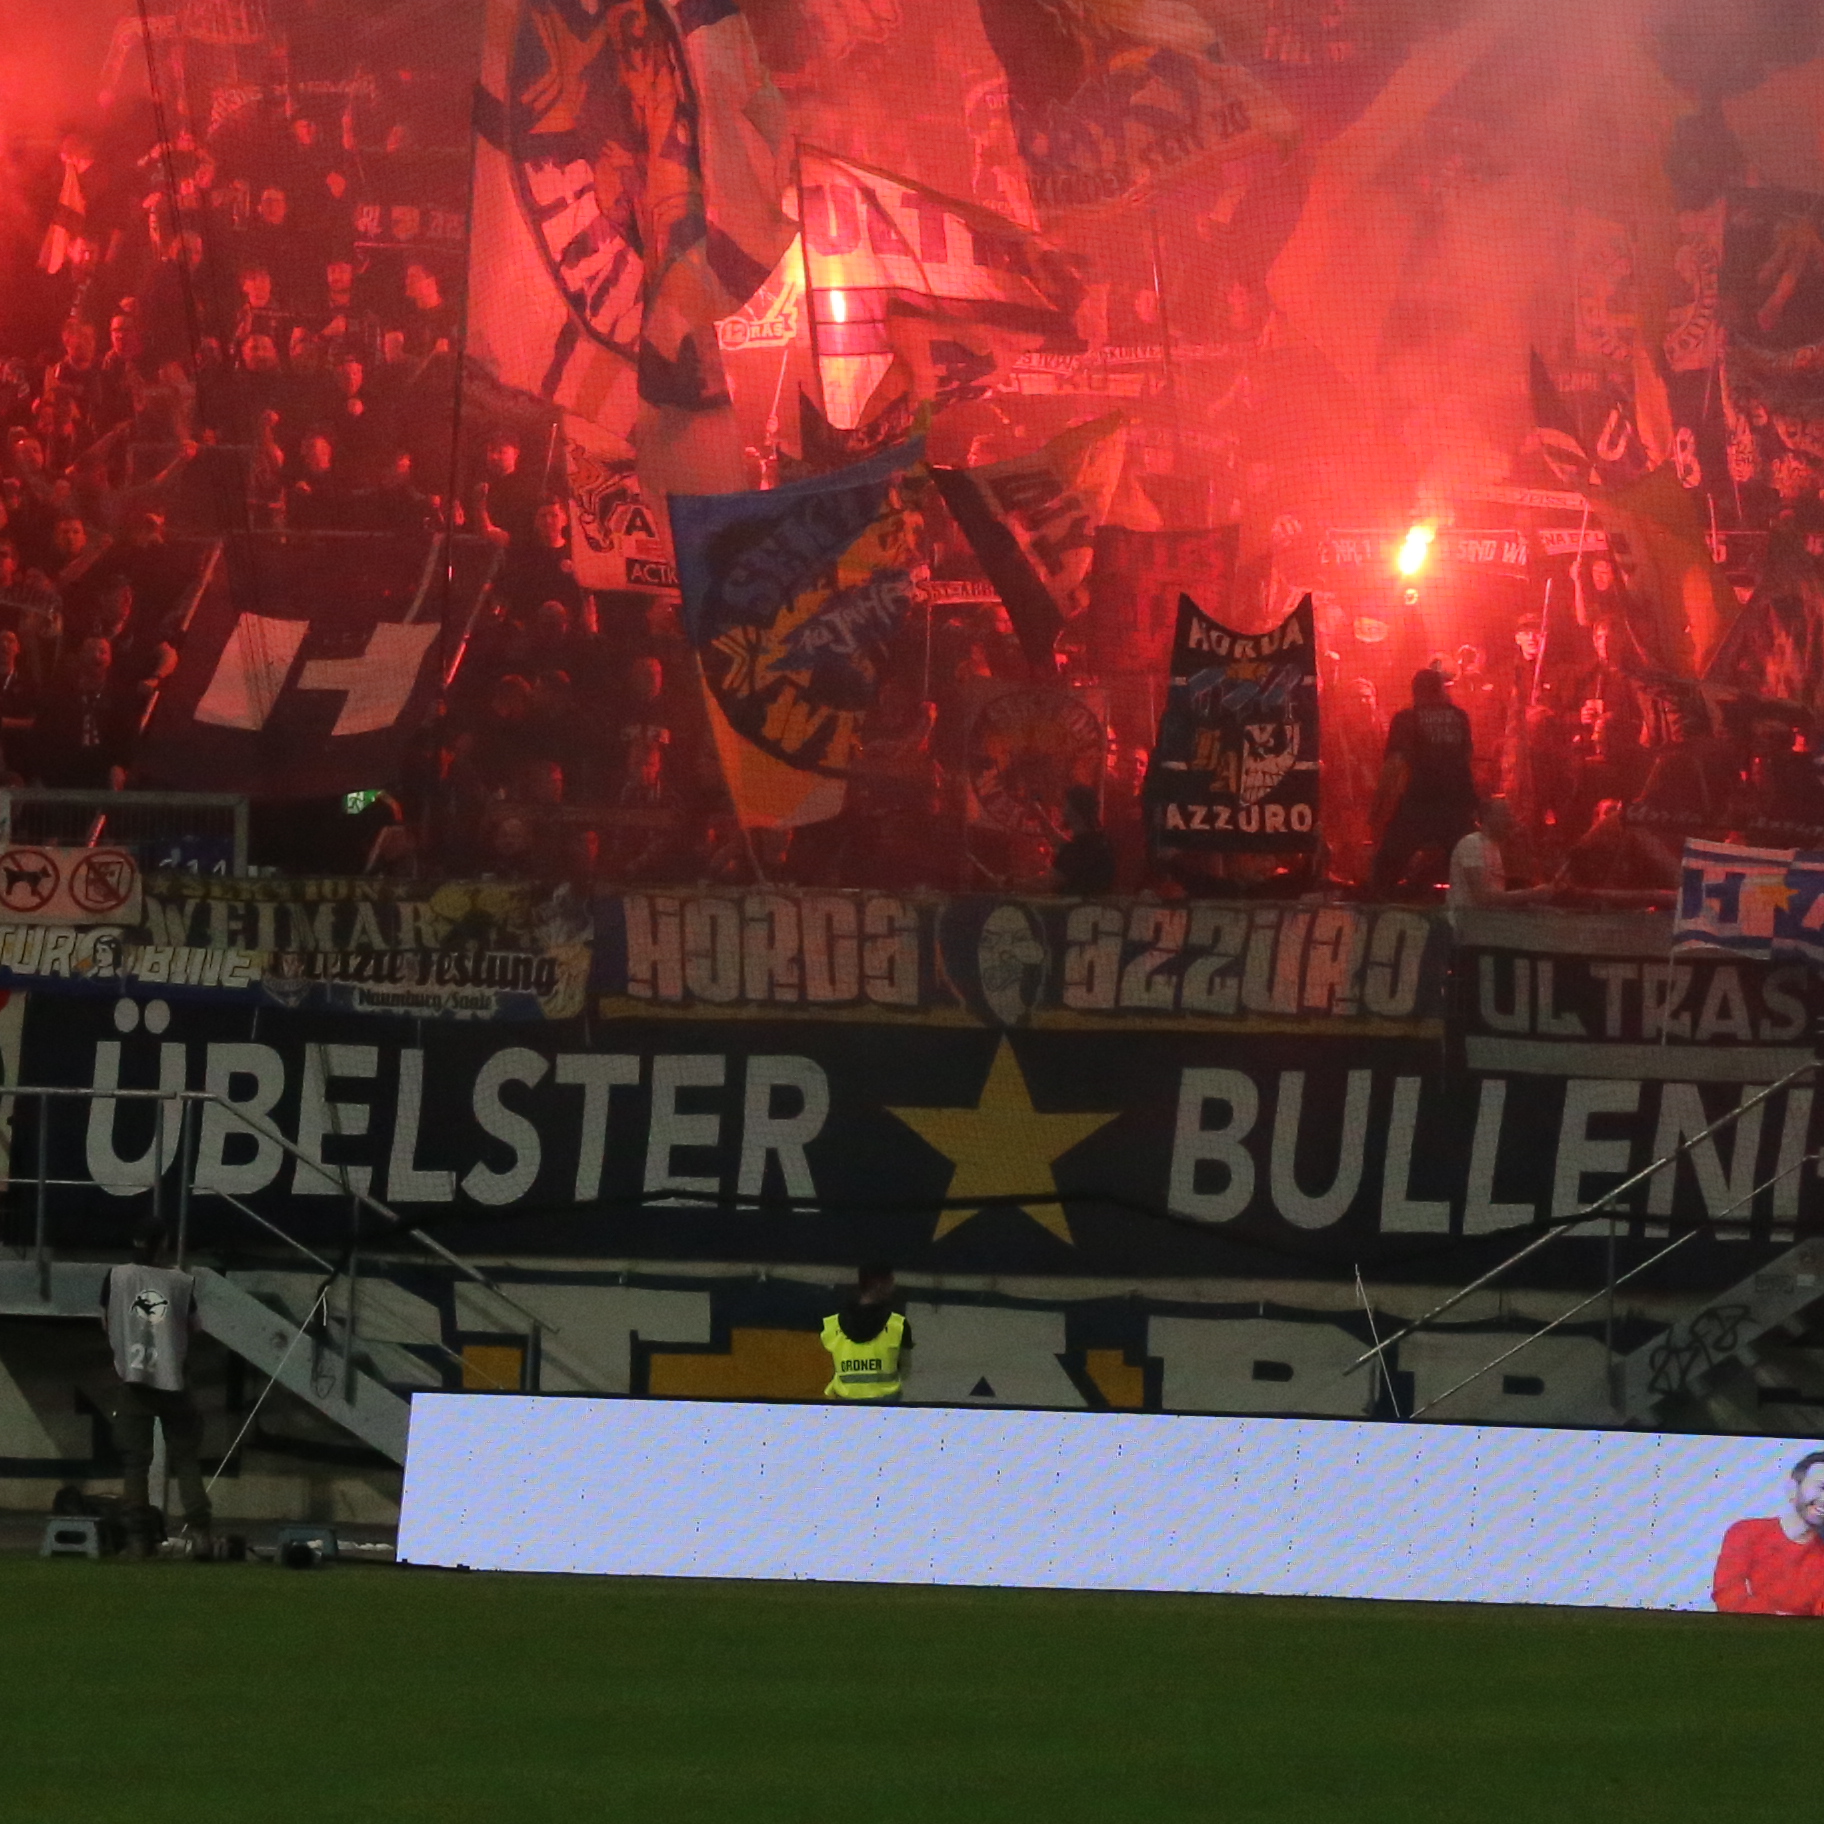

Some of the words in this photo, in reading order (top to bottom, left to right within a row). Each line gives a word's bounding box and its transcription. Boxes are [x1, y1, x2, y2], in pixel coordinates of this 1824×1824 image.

[1187, 617, 1305, 660] HORDA
[1165, 801, 1314, 834] AZZURO
[144, 897, 442, 952] WEIMAR
[1477, 951, 1811, 1042] ULTRAS
[86, 997, 831, 1213] ÜBELSTER
